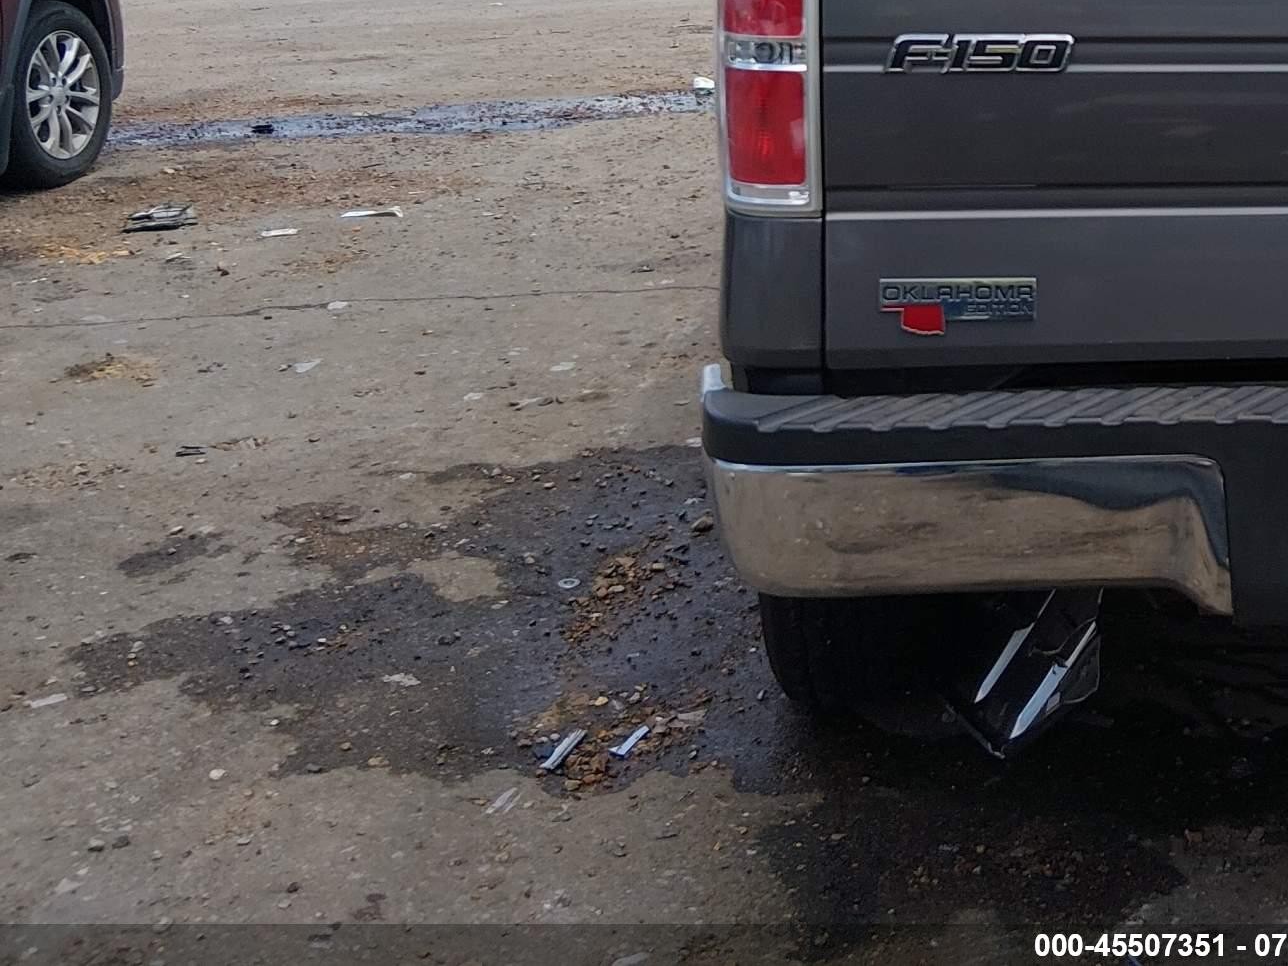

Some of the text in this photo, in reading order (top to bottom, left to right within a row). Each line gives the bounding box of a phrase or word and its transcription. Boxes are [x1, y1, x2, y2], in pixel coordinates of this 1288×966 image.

[883, 33, 1075, 74] F-150
[882, 285, 1034, 301] OKLAHOMA
[965, 304, 1034, 316] EDITION
